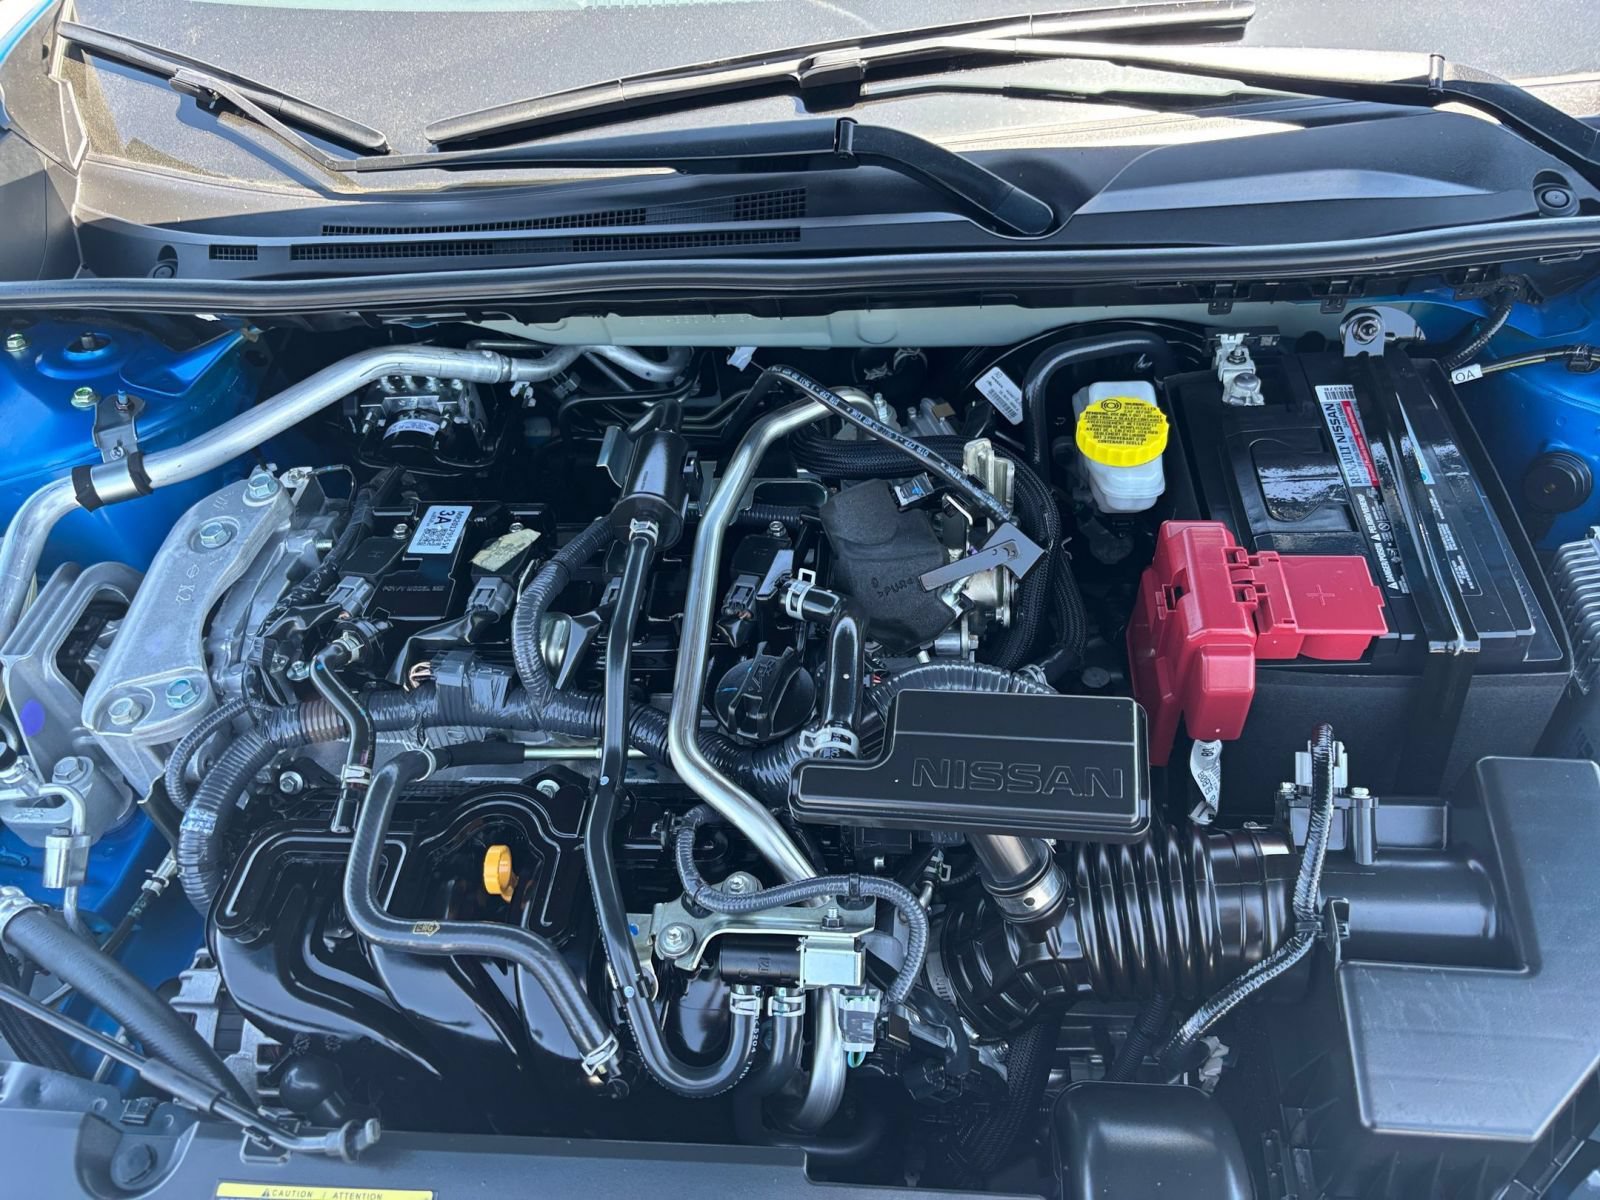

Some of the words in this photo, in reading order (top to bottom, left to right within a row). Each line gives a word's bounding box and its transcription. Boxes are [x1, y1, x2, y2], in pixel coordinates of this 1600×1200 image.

[1323, 403, 1348, 444] NISSAN
[1338, 445, 1363, 485] RENAULT
[434, 510, 456, 526] 3A
[911, 757, 1124, 799] NISSAN
[272, 1190, 313, 1198] CAUTION
[332, 1191, 384, 1200] ATTENTION
